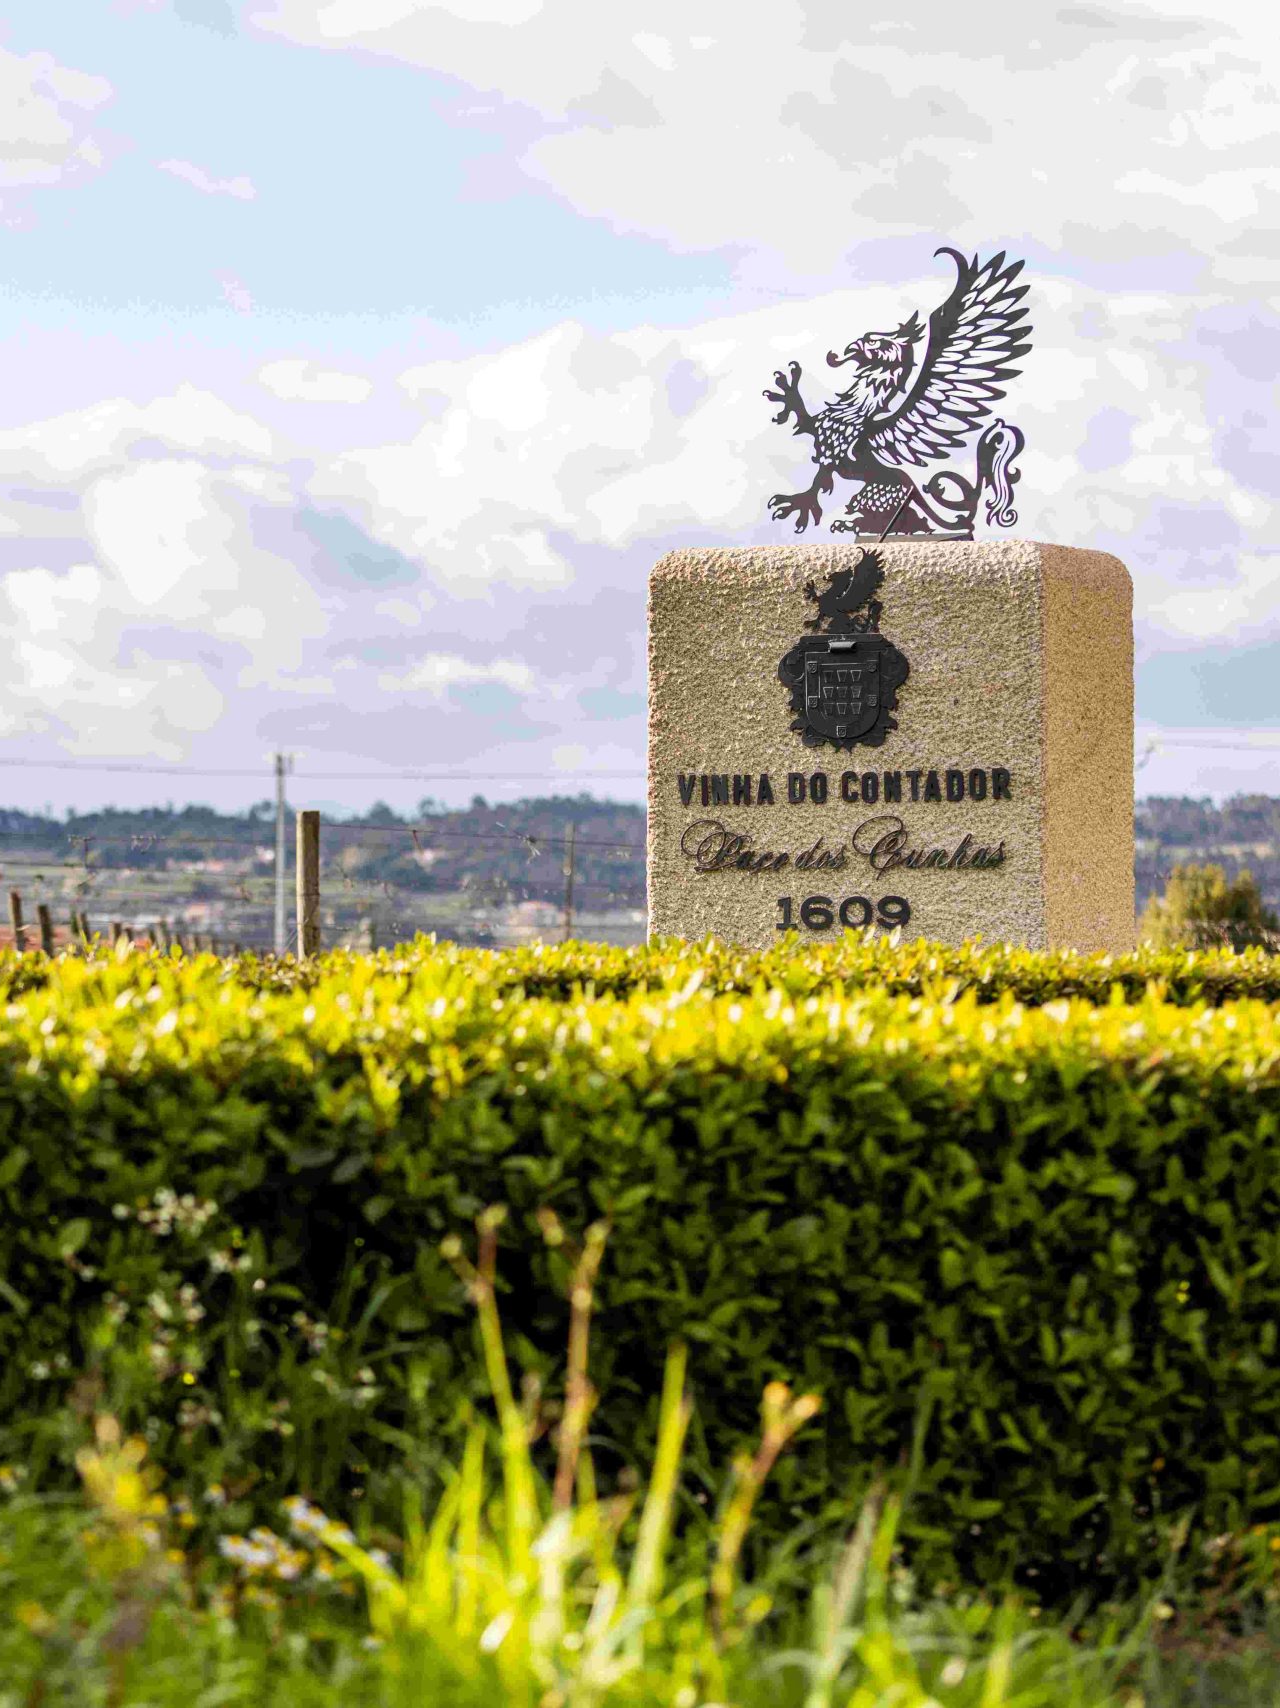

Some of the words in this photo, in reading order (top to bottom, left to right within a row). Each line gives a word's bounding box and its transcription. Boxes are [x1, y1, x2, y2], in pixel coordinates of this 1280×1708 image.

[677, 773, 774, 806] VINHA
[788, 772, 828, 803] DO
[841, 767, 1011, 803] CONTADOR
[794, 836, 847, 869] dos
[852, 815, 1005, 880] Cunhas
[776, 895, 911, 930] 1609
